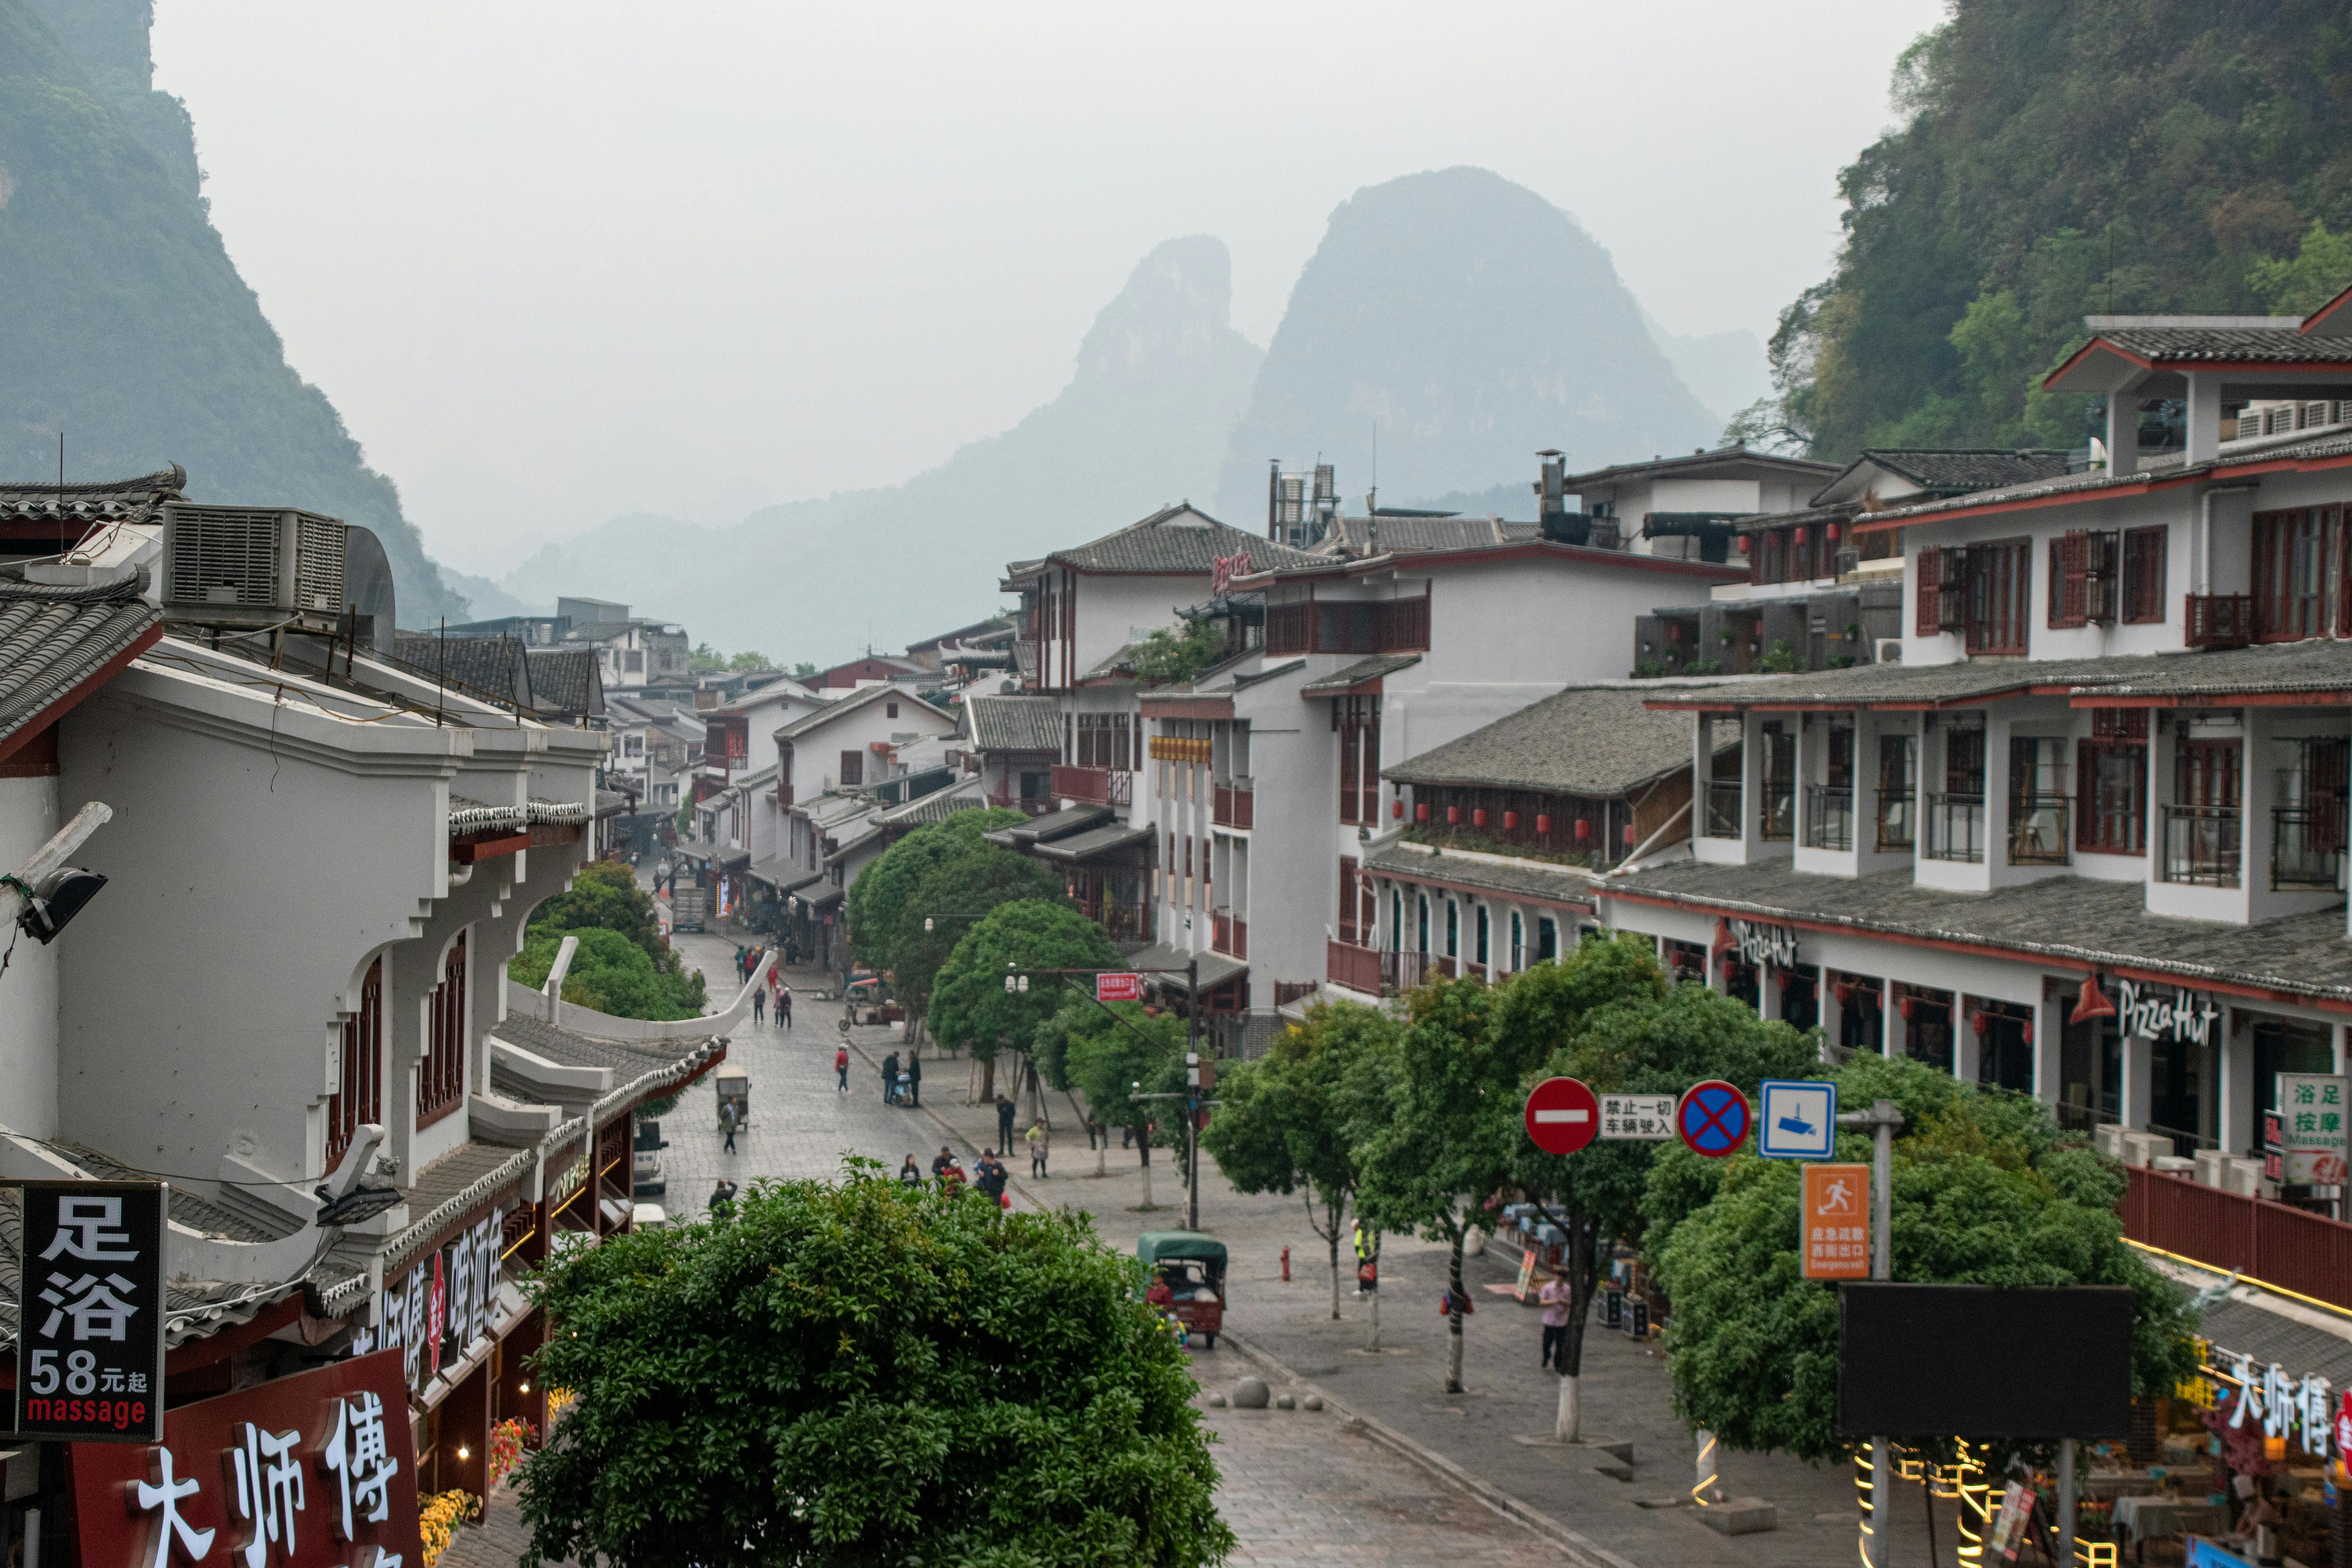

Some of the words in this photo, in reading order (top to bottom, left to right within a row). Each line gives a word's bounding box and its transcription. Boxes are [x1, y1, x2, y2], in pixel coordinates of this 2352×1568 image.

[1739, 920, 1772, 965] Pizza
[1771, 926, 1797, 969] Hut
[2118, 980, 2174, 1041] Pizza
[2172, 989, 2218, 1048] Hut
[1606, 1100, 1671, 1116] 禁止一切
[2295, 1084, 2340, 1104] 浴足
[1606, 1118, 1671, 1134] 车辆驶入
[2288, 1135, 2348, 1147] Massage
[2296, 1111, 2341, 1133] 按摩
[38, 1196, 140, 1341] 足浴
[449, 1206, 503, 1363] 啤酒鱼
[27, 1398, 146, 1430] massage
[2228, 1354, 2332, 1457] 大师傅
[138, 1391, 398, 1568] 大师傅
